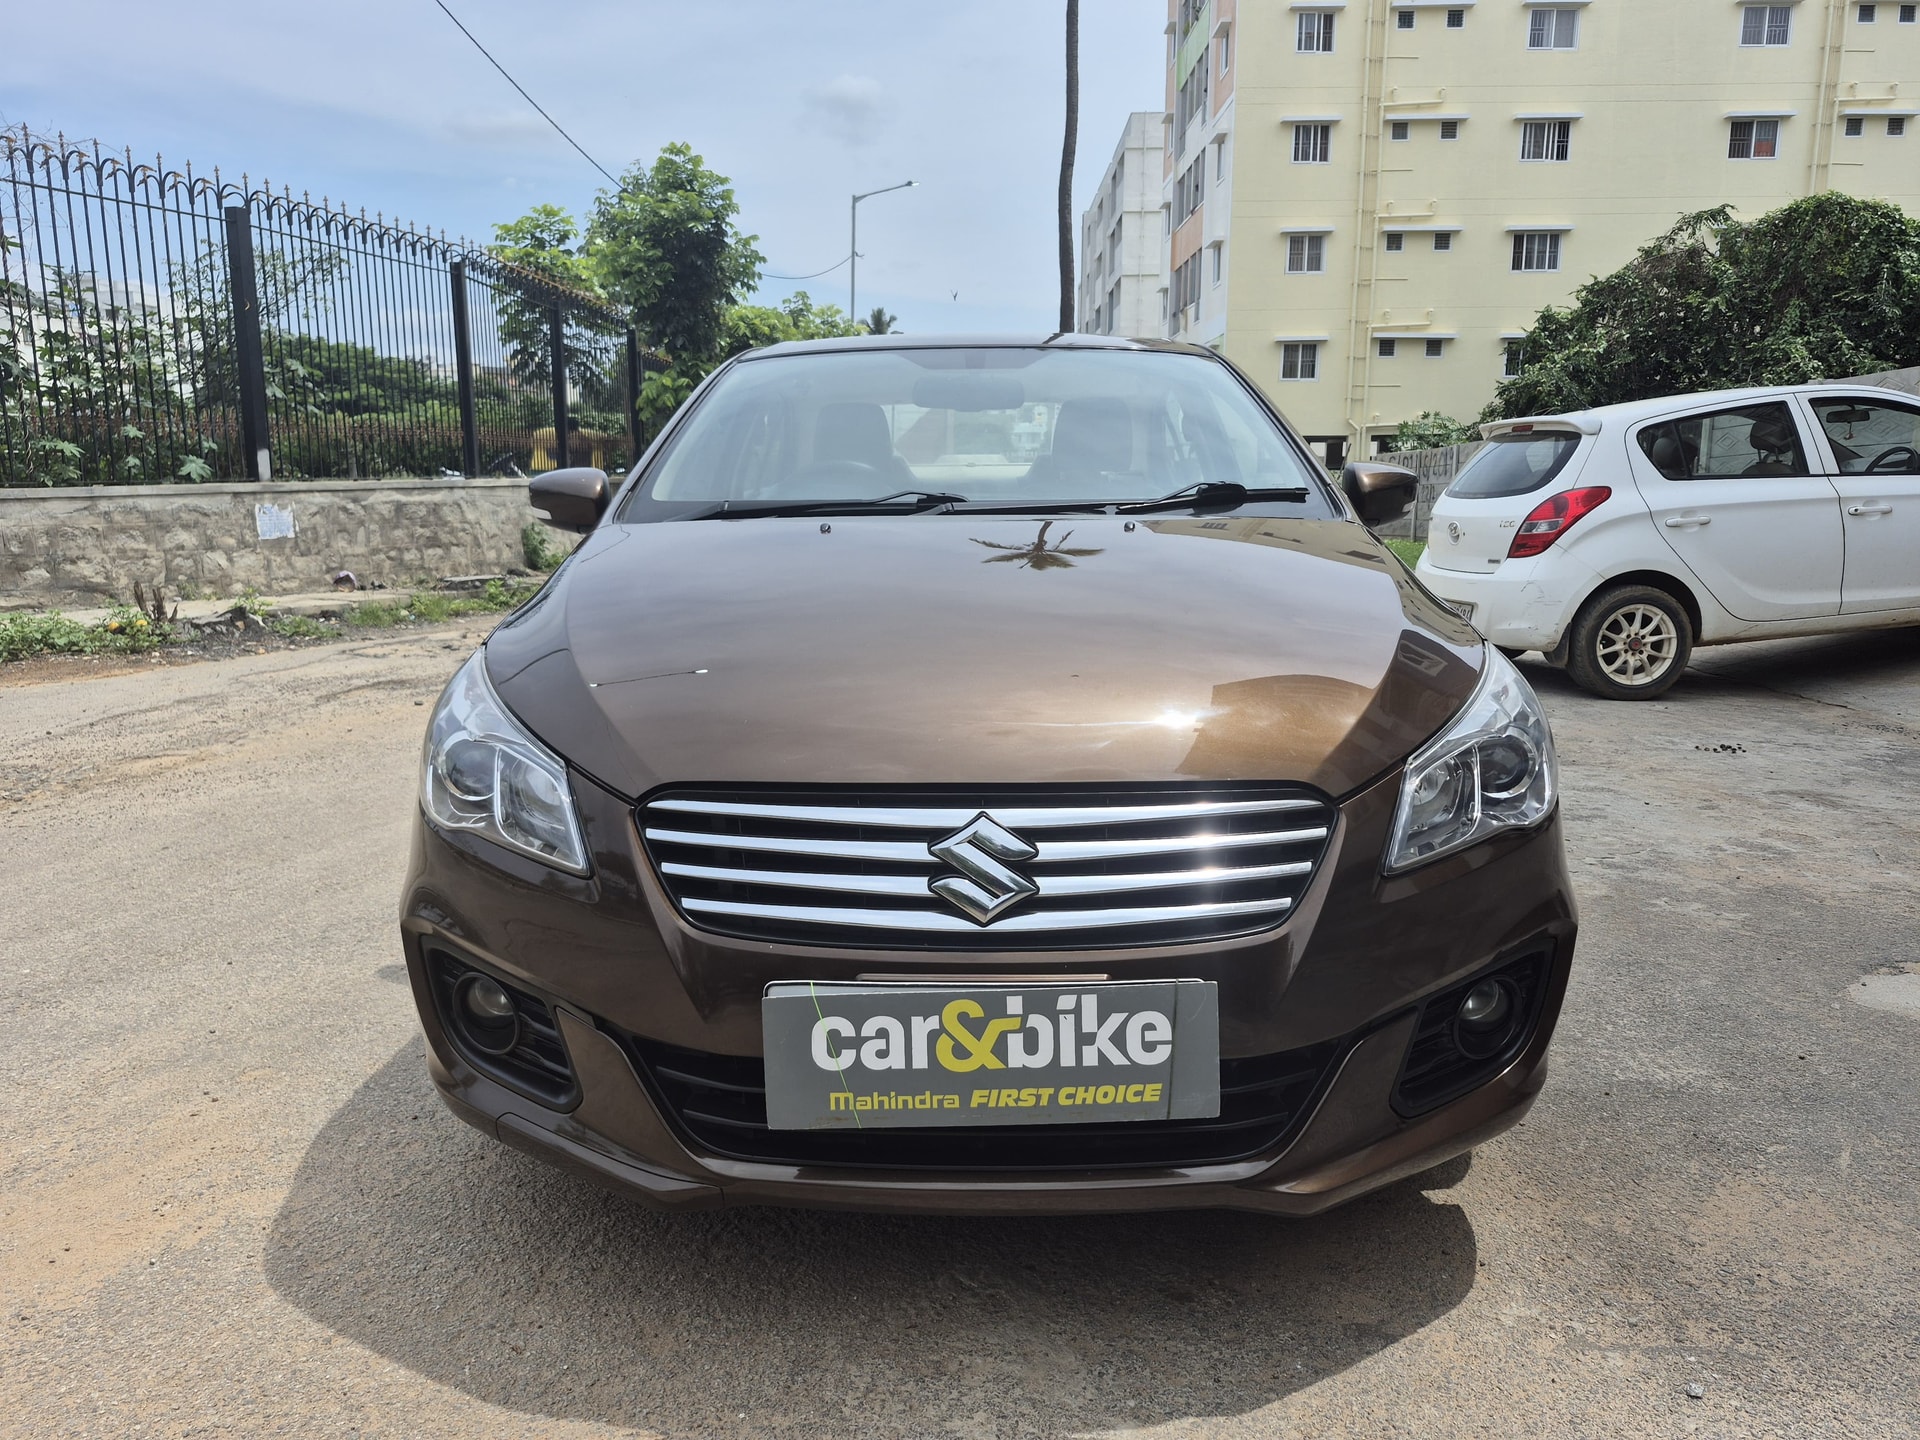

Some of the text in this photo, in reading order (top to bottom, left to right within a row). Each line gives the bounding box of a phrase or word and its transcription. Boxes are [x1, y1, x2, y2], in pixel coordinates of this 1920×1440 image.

[811, 994, 1173, 1073] car&bike
[829, 1083, 1163, 1111] Mahindra FIRST CHOICE
